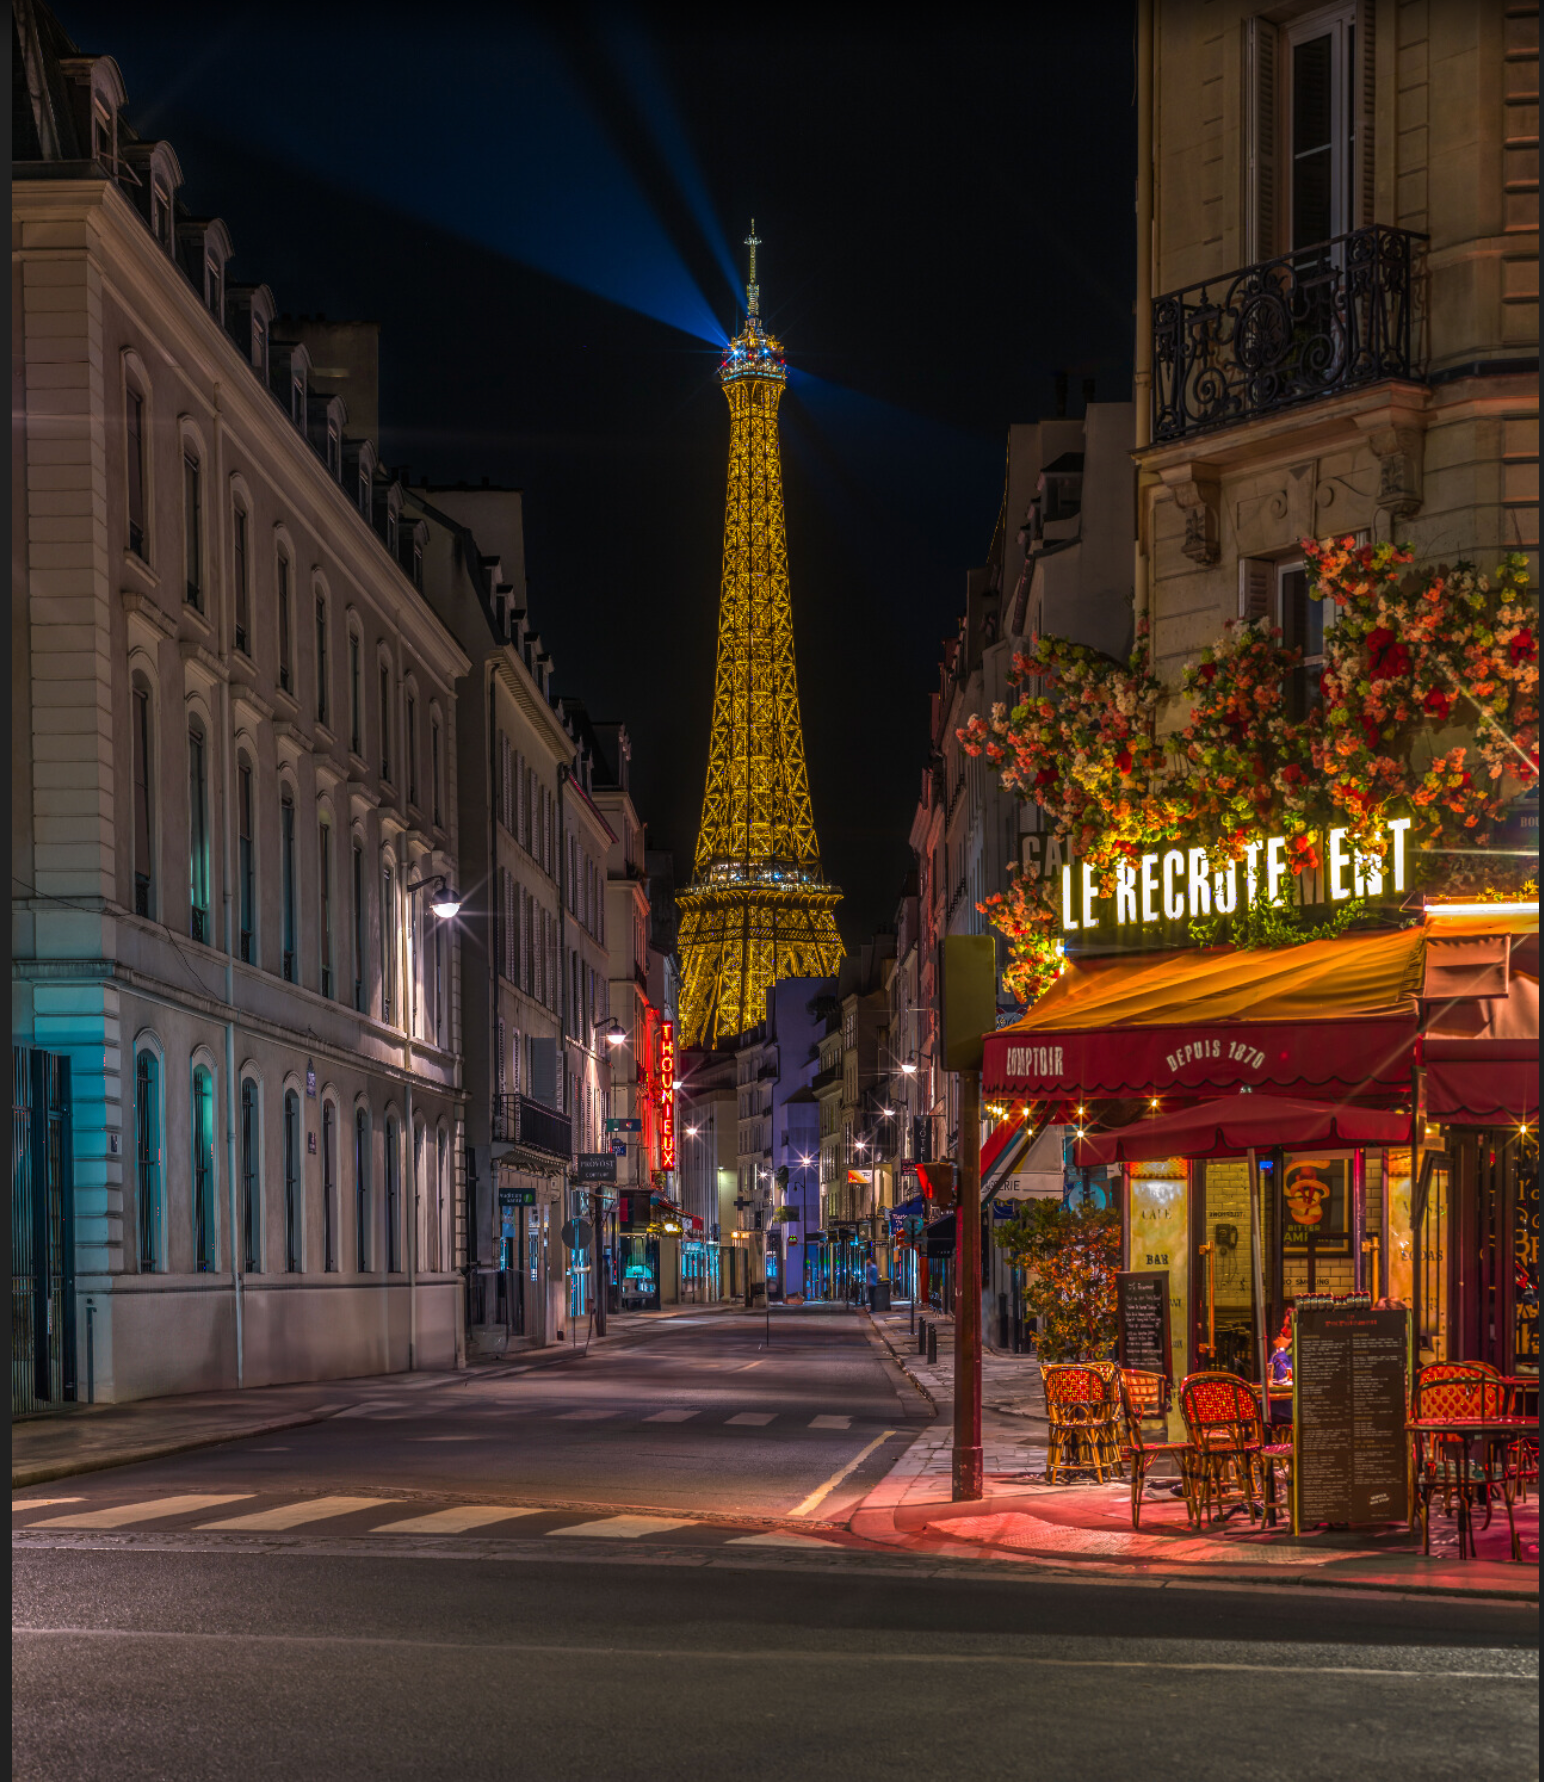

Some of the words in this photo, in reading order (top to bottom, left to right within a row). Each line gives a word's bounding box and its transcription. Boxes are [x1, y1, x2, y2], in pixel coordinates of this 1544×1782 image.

[1062, 862, 1099, 930] LE
[1006, 1046, 1064, 1077] COMPTOIR
[1166, 1039, 1221, 1072] DEPUIS
[1228, 1041, 1265, 1070] 1870
[1287, 1224, 1321, 1232] BITTER
[1146, 1254, 1169, 1265] BAR
